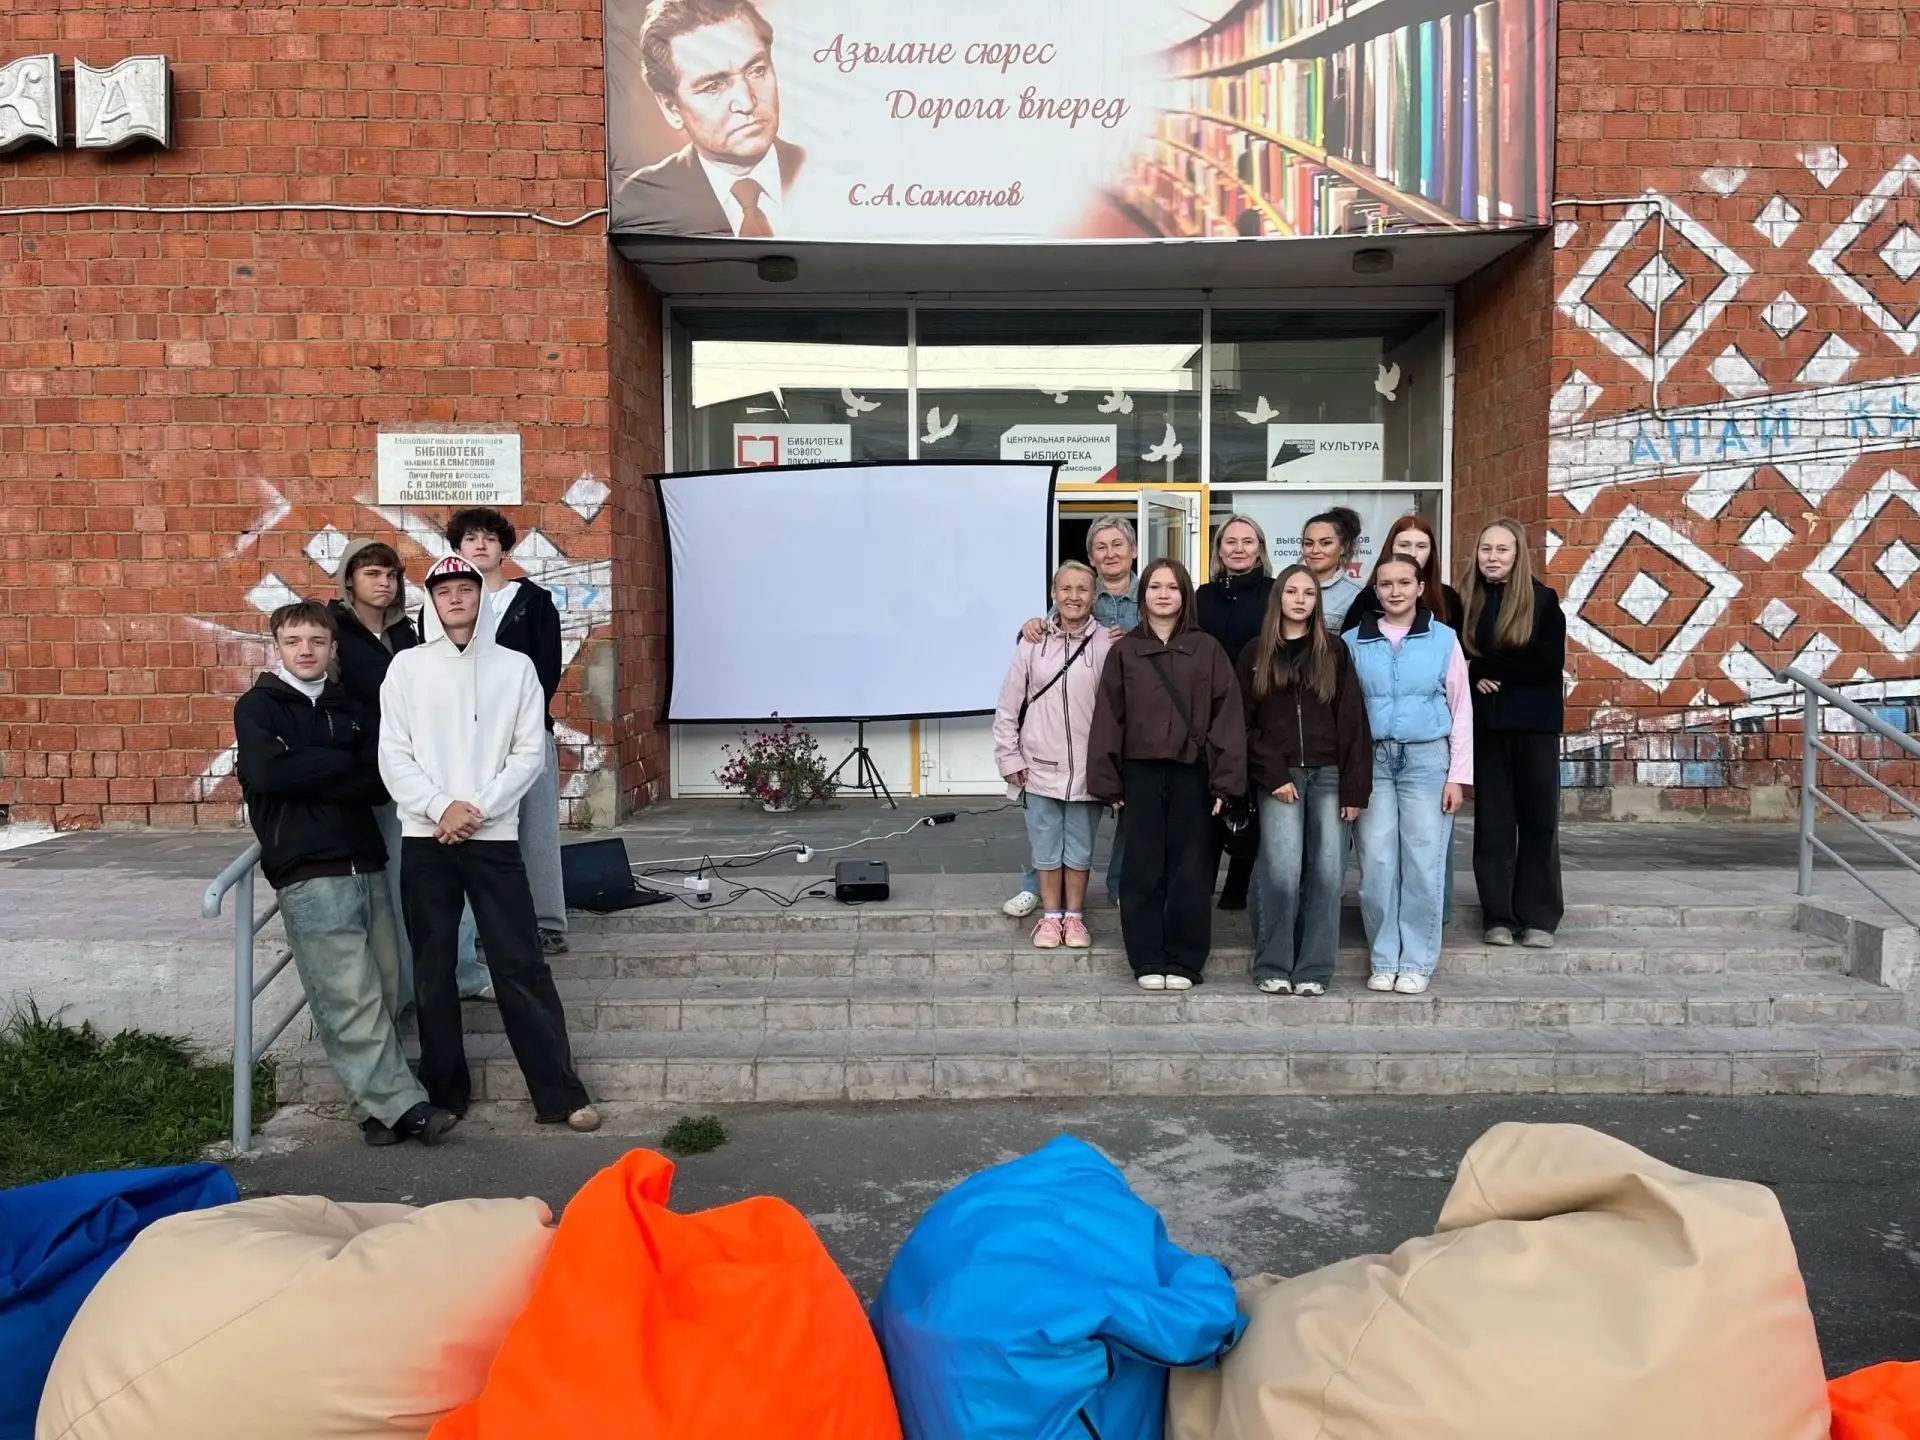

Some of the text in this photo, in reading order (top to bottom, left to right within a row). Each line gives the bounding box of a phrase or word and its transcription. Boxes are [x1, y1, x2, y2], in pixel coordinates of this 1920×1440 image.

[964, 41, 1057, 74] сюрес
[885, 85, 1131, 129] Дорога вперед
[787, 437, 844, 446] БИБЛИОТЕКА
[1006, 434, 1111, 444] ЦЕНТРАЛЬНАЯ РАЙОННАЯ
[1319, 441, 1380, 451] КУЛЬТУРА
[415, 446, 484, 457] БИБЛИОТЕКА
[787, 447, 822, 456] НОВОГО
[1023, 450, 1092, 460] БИБЛИОТЕКА
[447, 458, 495, 466] САМСОНОВА
[425, 481, 467, 489] САМСОНОВ
[475, 490, 501, 501] ЮРТ
[1276, 537, 1302, 545] ВЫБО
